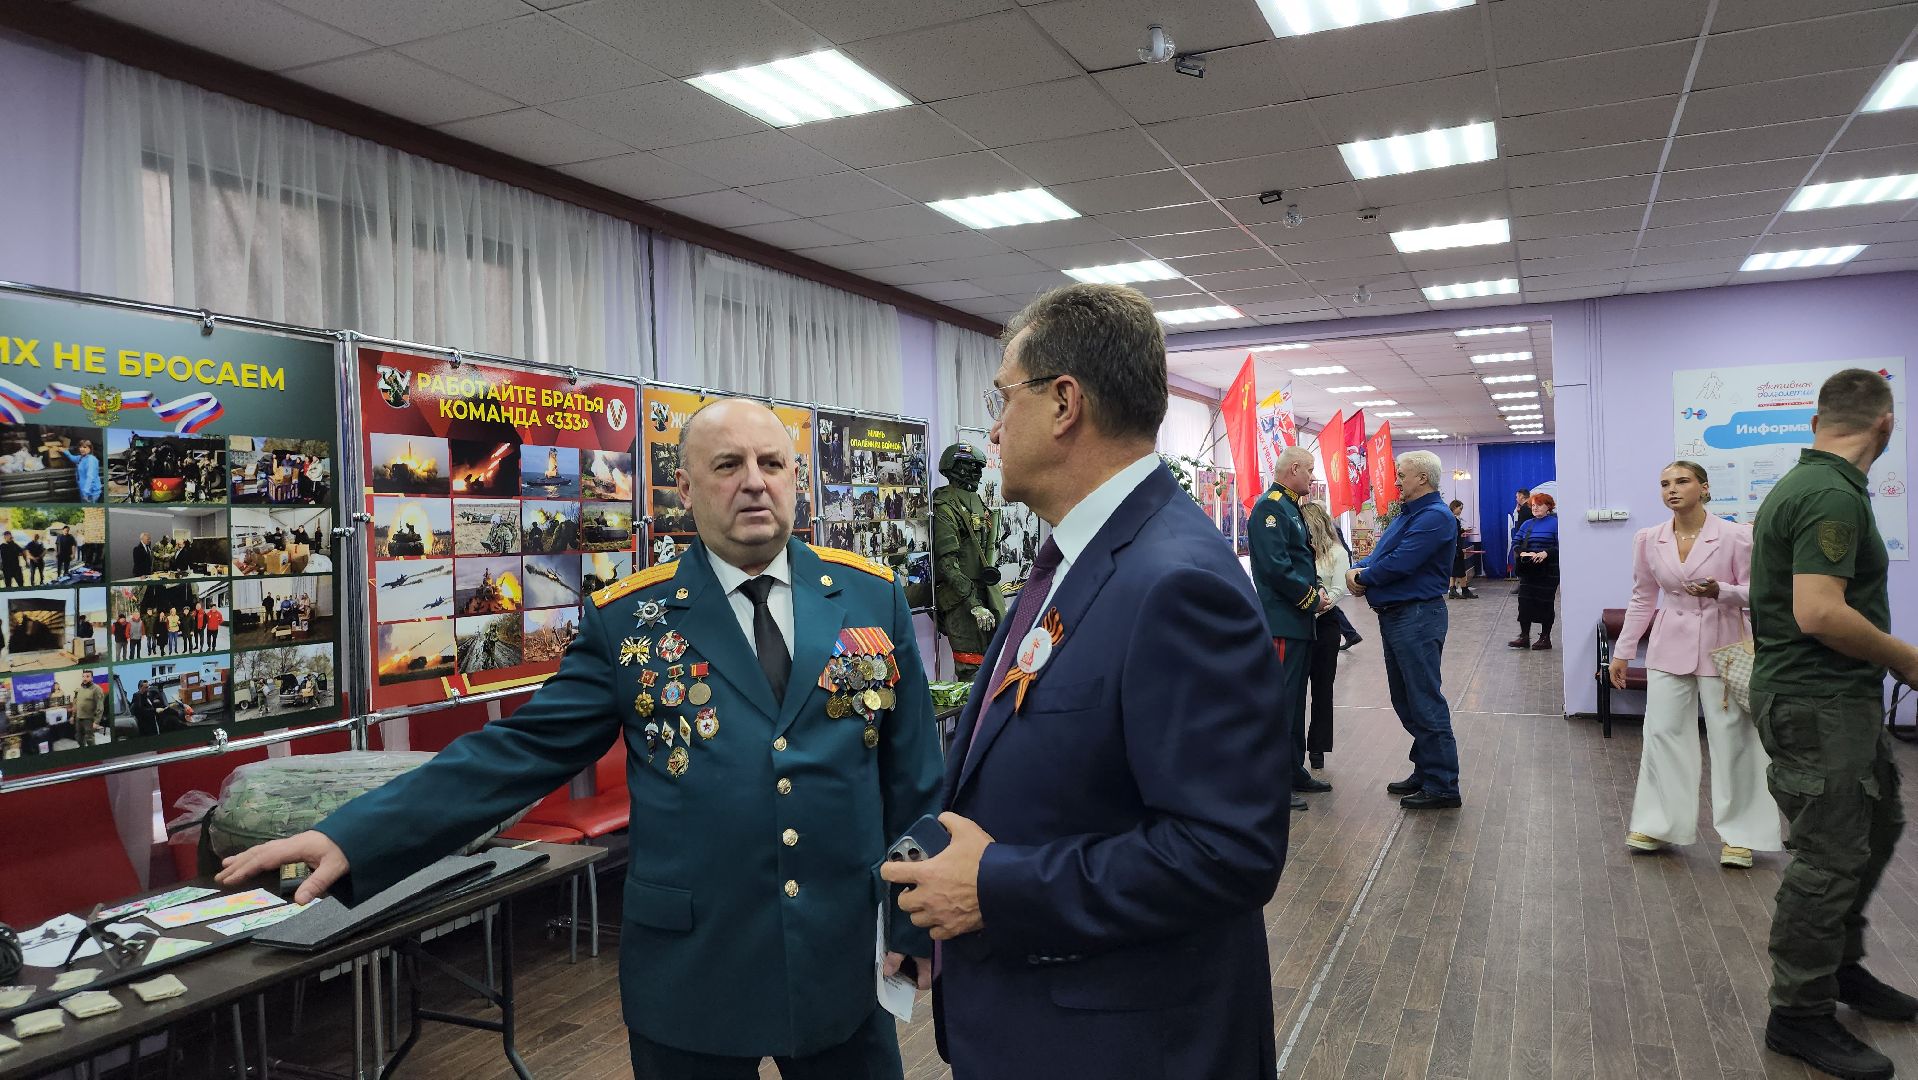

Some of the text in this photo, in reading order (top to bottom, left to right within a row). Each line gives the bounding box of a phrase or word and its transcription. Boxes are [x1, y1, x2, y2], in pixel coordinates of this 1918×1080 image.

[53, 341, 107, 374] НЕ
[118, 349, 286, 391] БРОСАЕМ
[416, 372, 604, 414] РАБОТАЙТЕ БРАТЬЯ
[439, 398, 589, 432] КОМАНДА «333»
